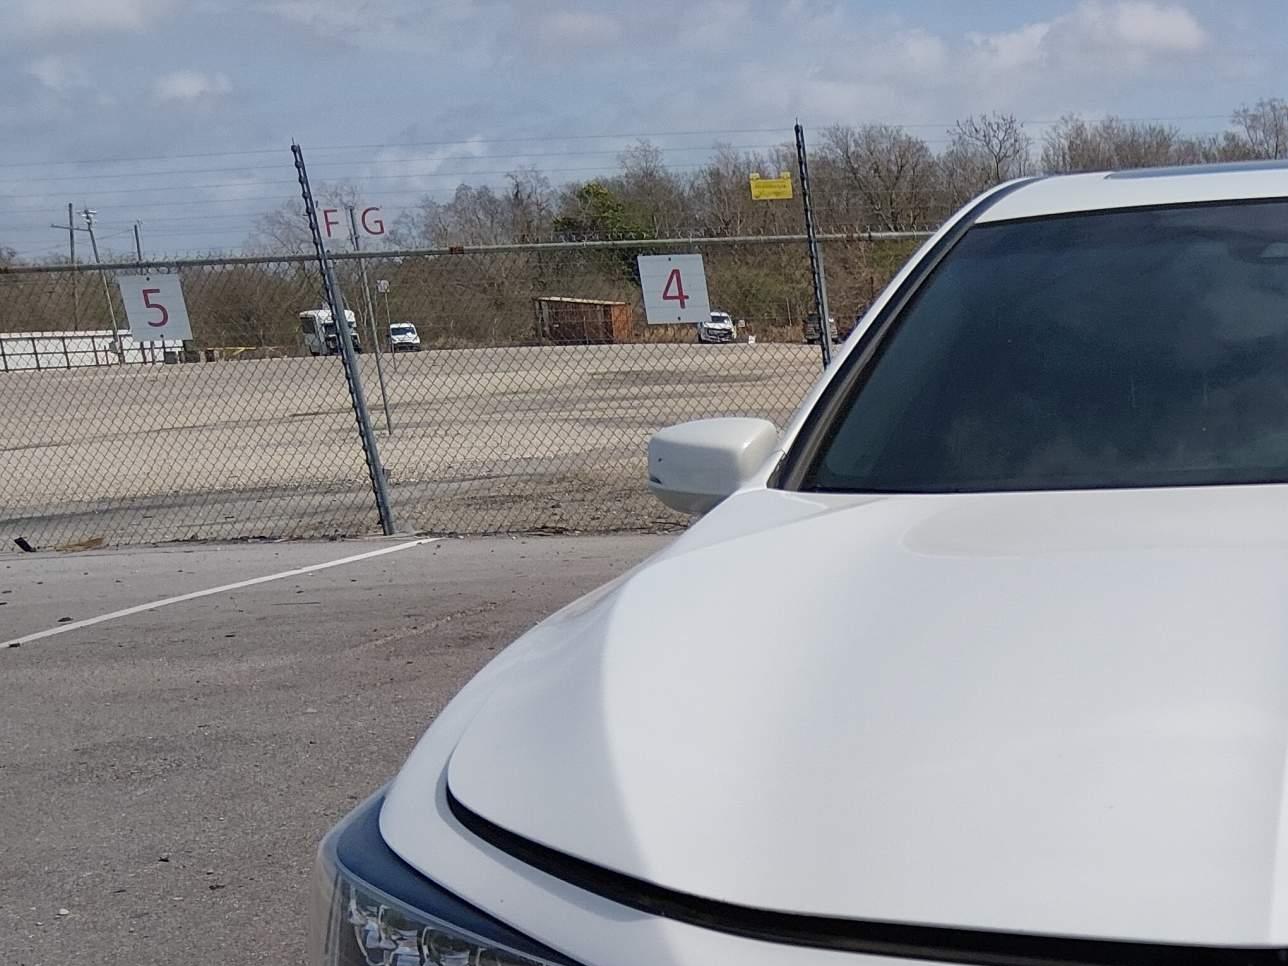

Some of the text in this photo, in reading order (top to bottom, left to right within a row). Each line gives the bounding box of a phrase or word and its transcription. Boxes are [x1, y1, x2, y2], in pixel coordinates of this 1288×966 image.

[323, 208, 340, 238] F
[361, 206, 385, 236] G
[662, 268, 690, 310] 4
[142, 288, 169, 328] 5
